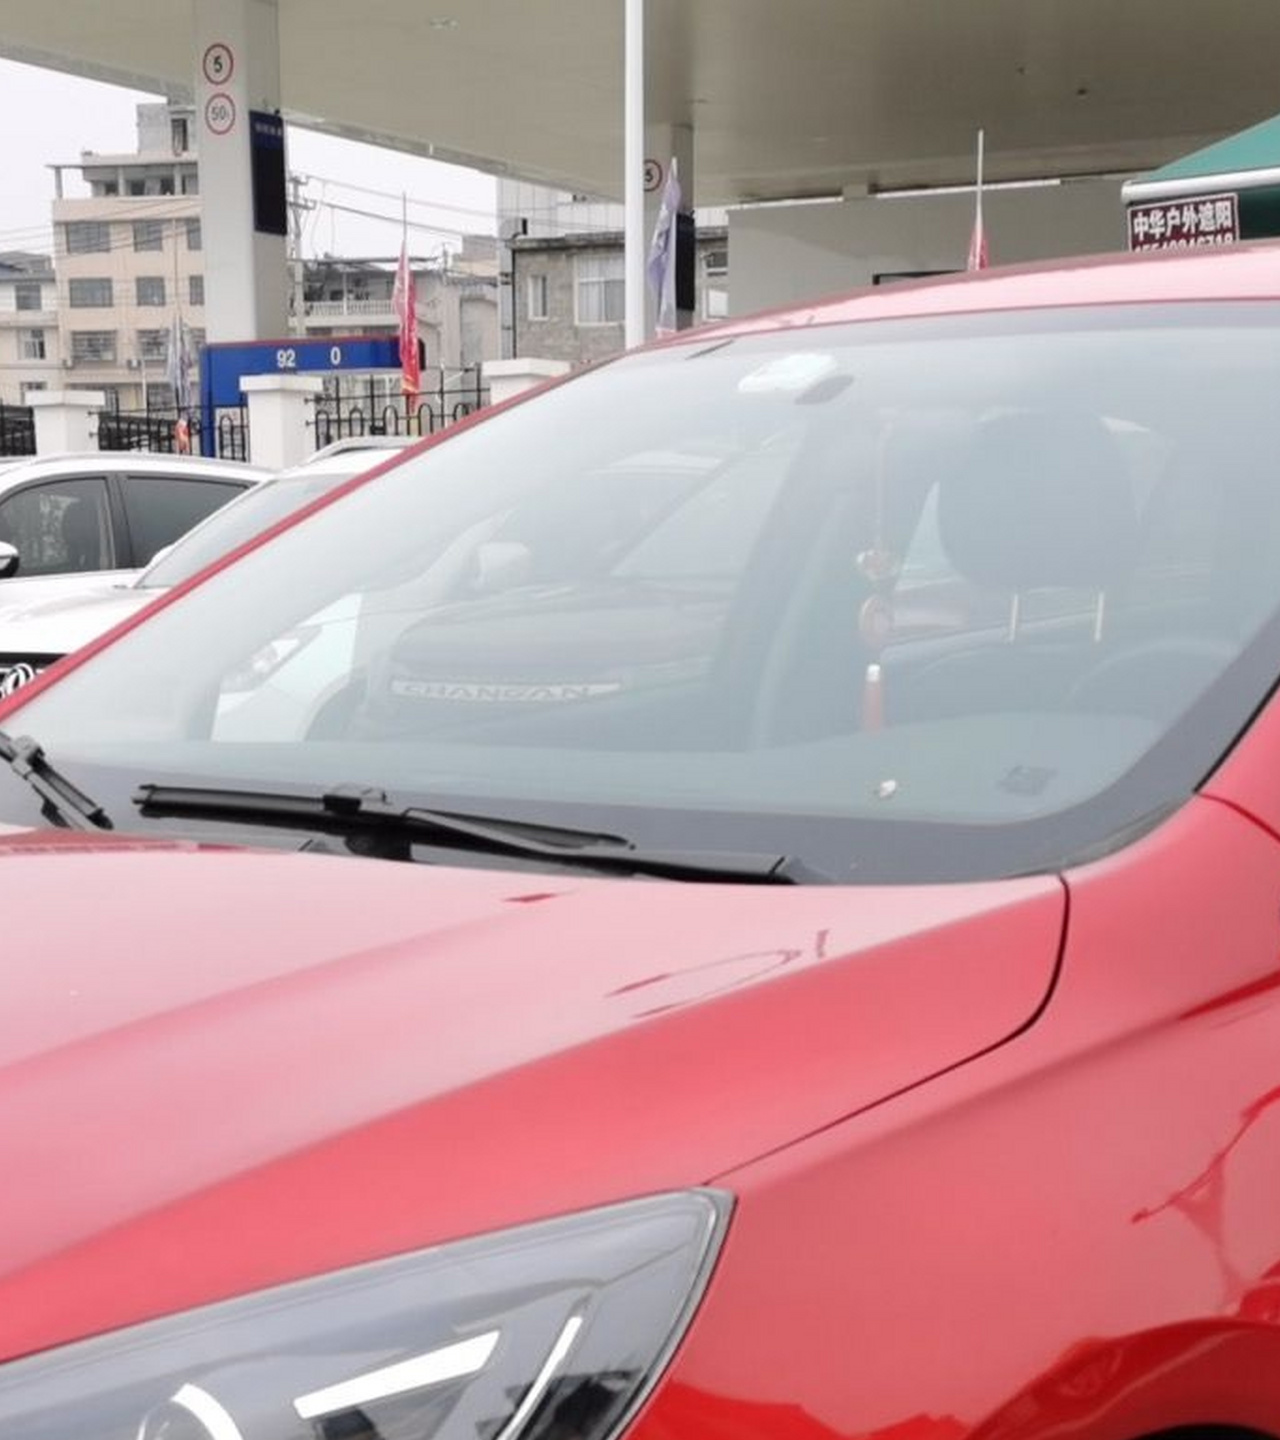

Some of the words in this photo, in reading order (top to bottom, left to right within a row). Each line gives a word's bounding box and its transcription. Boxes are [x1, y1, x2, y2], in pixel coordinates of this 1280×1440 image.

[1133, 199, 1233, 241] 中华户外遮阳
[276, 349, 296, 368] 92
[330, 346, 342, 365] 0
